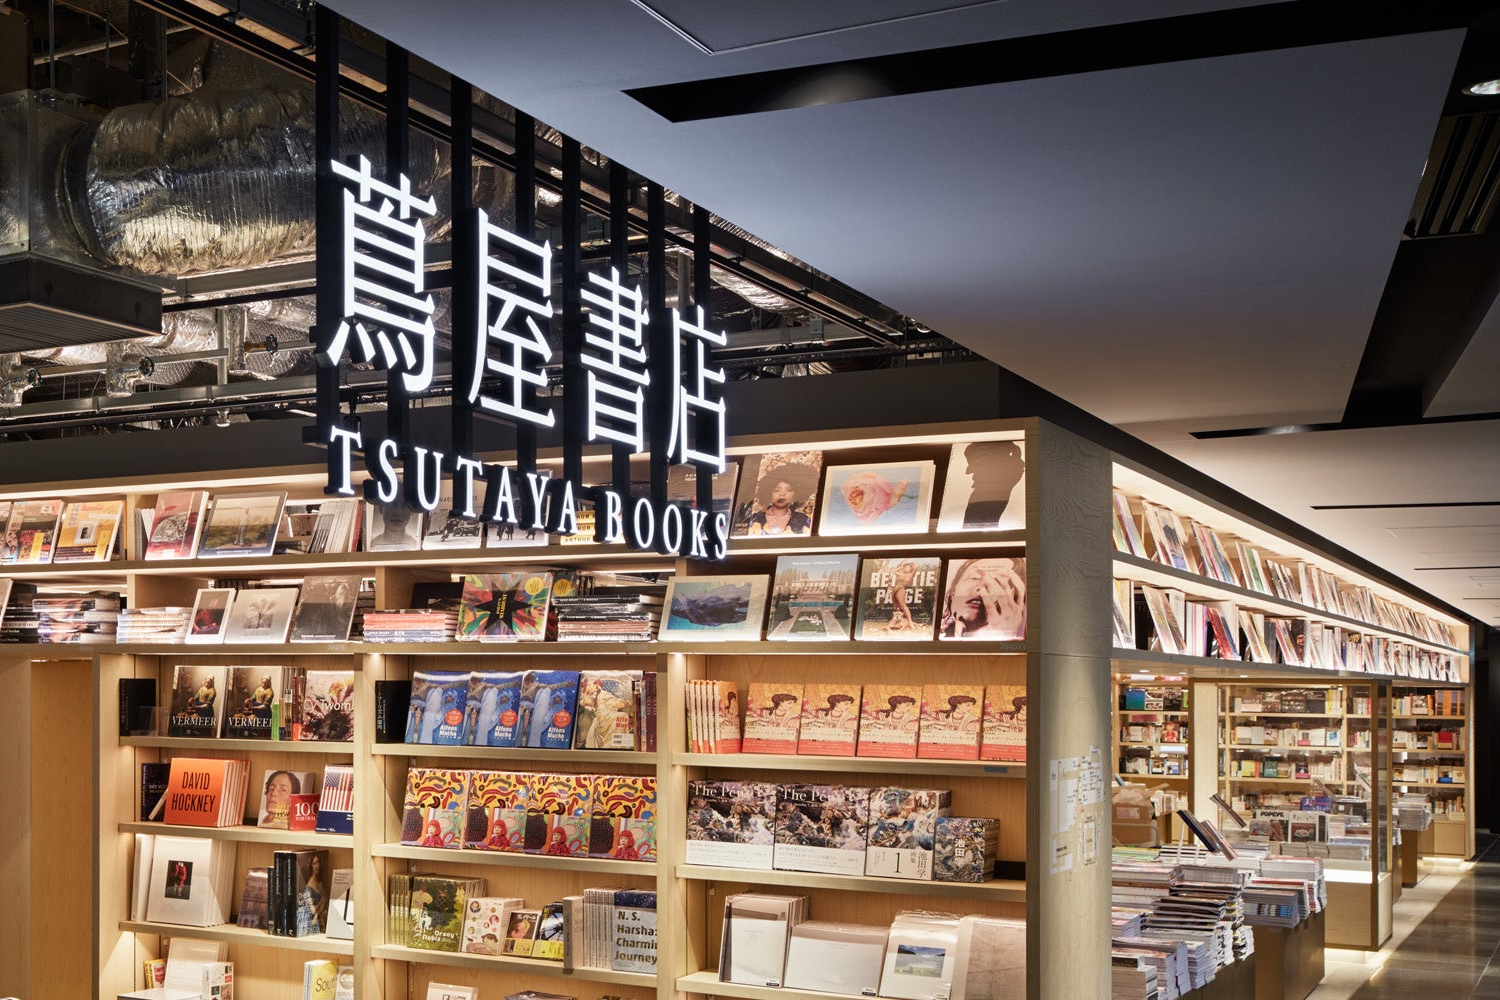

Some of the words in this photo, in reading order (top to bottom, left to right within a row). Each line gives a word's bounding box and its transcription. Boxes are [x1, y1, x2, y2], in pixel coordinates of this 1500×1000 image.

[326, 154, 728, 475] 蔦屋書店
[328, 426, 578, 534] TSUTAYA
[604, 490, 728, 560] BOOKS
[319, 700, 354, 711] Twom
[172, 715, 217, 727] VERMEER
[181, 771, 211, 790] DAVID
[692, 785, 718, 797] The
[781, 789, 807, 801] The
[171, 793, 217, 813] HOCKNEY
[618, 911, 629, 921] N.
[631, 912, 641, 922] S.
[614, 950, 658, 966] Journey
